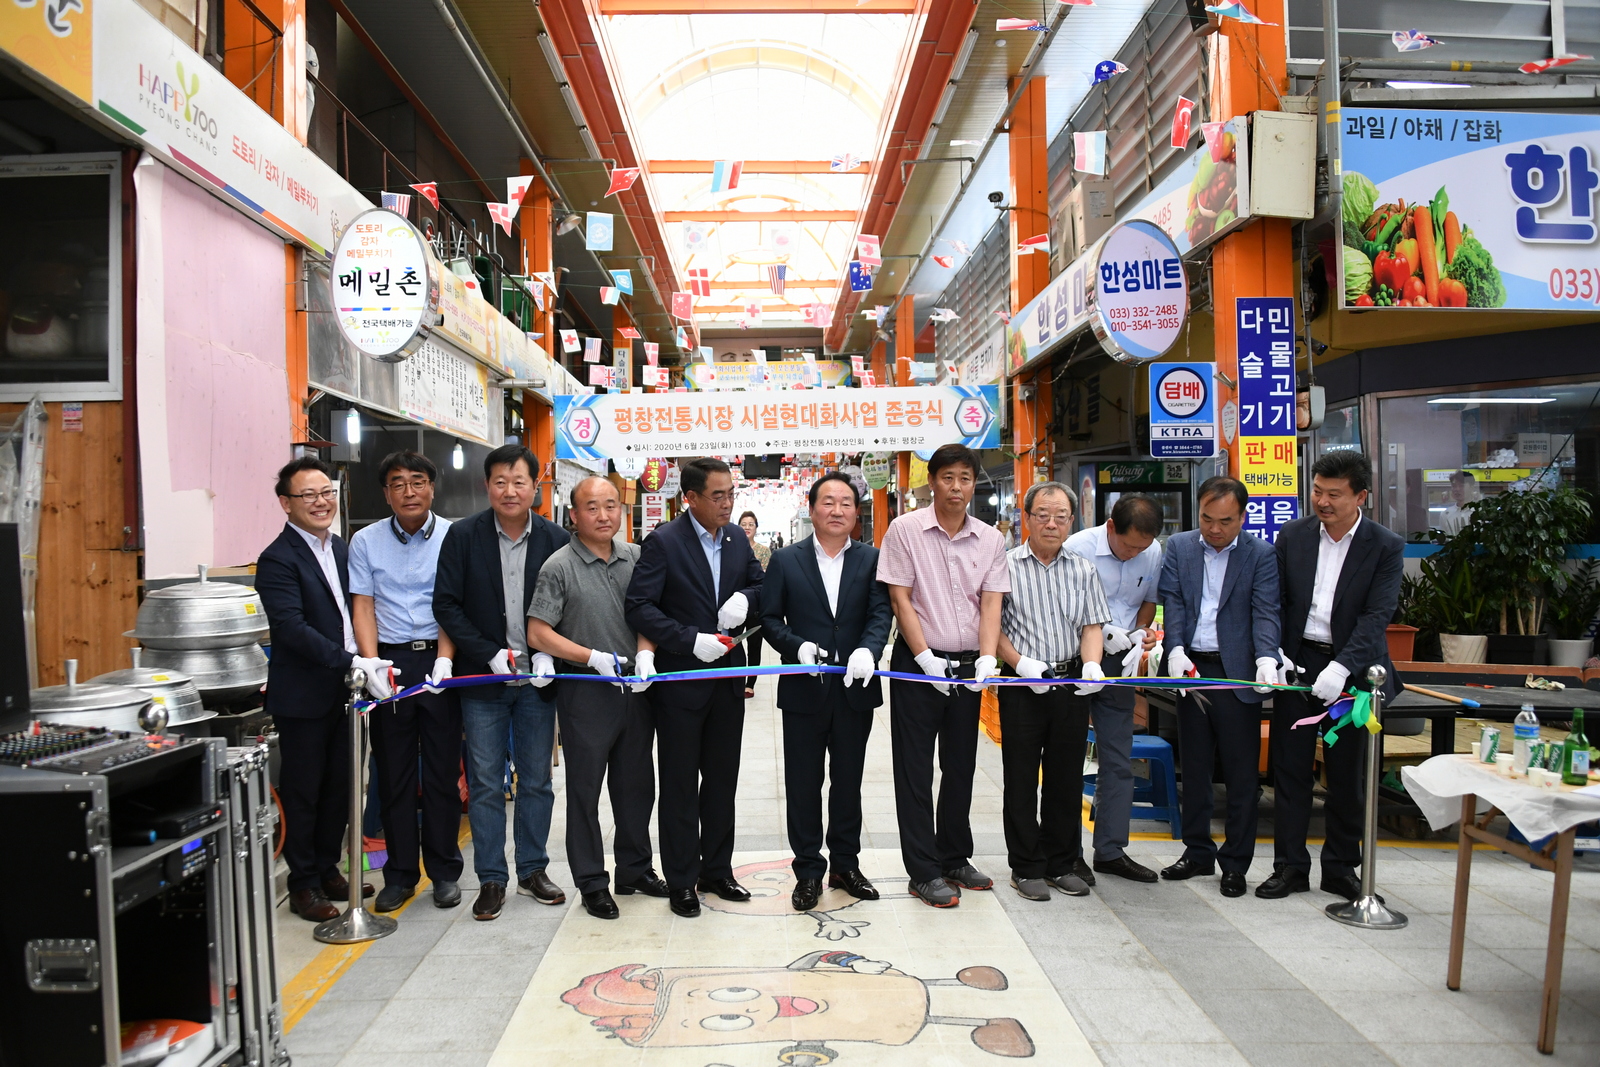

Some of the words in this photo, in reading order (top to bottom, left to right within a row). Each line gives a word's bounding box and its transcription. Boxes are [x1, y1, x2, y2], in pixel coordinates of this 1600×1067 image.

[139, 93, 180, 130] PYEONG
[186, 127, 218, 156] CHANG
[1346, 115, 1385, 139] 과일
[1403, 117, 1443, 141] 야채
[1463, 119, 1502, 143] 잡화
[232, 135, 257, 171] 도토리
[264, 158, 280, 188] 감자
[286, 176, 319, 216] 메밀부치기
[355, 224, 383, 234] 도토리
[360, 236, 379, 246] 감자
[346, 248, 393, 259] 메밀부치기
[1100, 258, 1182, 294] 한성마트
[1109, 307, 1130, 319] 033)
[1132, 304, 1178, 317] 332-2485
[362, 319, 414, 328] 전국택배가능
[1110, 317, 1180, 332] 010-3541-3055
[1240, 307, 1264, 429] 다슬기
[1268, 307, 1294, 430] 민물고기
[1164, 382, 1200, 399] 담배
[614, 405, 733, 434] 평창전통시장
[740, 401, 878, 431] 시설현대화사업
[884, 399, 944, 427] 준공식
[963, 406, 983, 427] 축
[573, 417, 591, 438] 경
[1161, 428, 1203, 437] KTRA
[633, 443, 652, 451] 일시:
[654, 442, 682, 451] 2020년
[684, 441, 697, 450] 6월
[700, 440, 731, 450] 23일(화)
[733, 441, 756, 449] 13:00
[772, 439, 791, 448] 주관:
[793, 437, 865, 447] 평창전통시장상인회
[881, 436, 900, 445] 후원:
[902, 436, 925, 445] 평창군
[1245, 441, 1293, 465] 판매
[1244, 473, 1293, 486] 택배가능
[1245, 501, 1294, 524] 얼음
